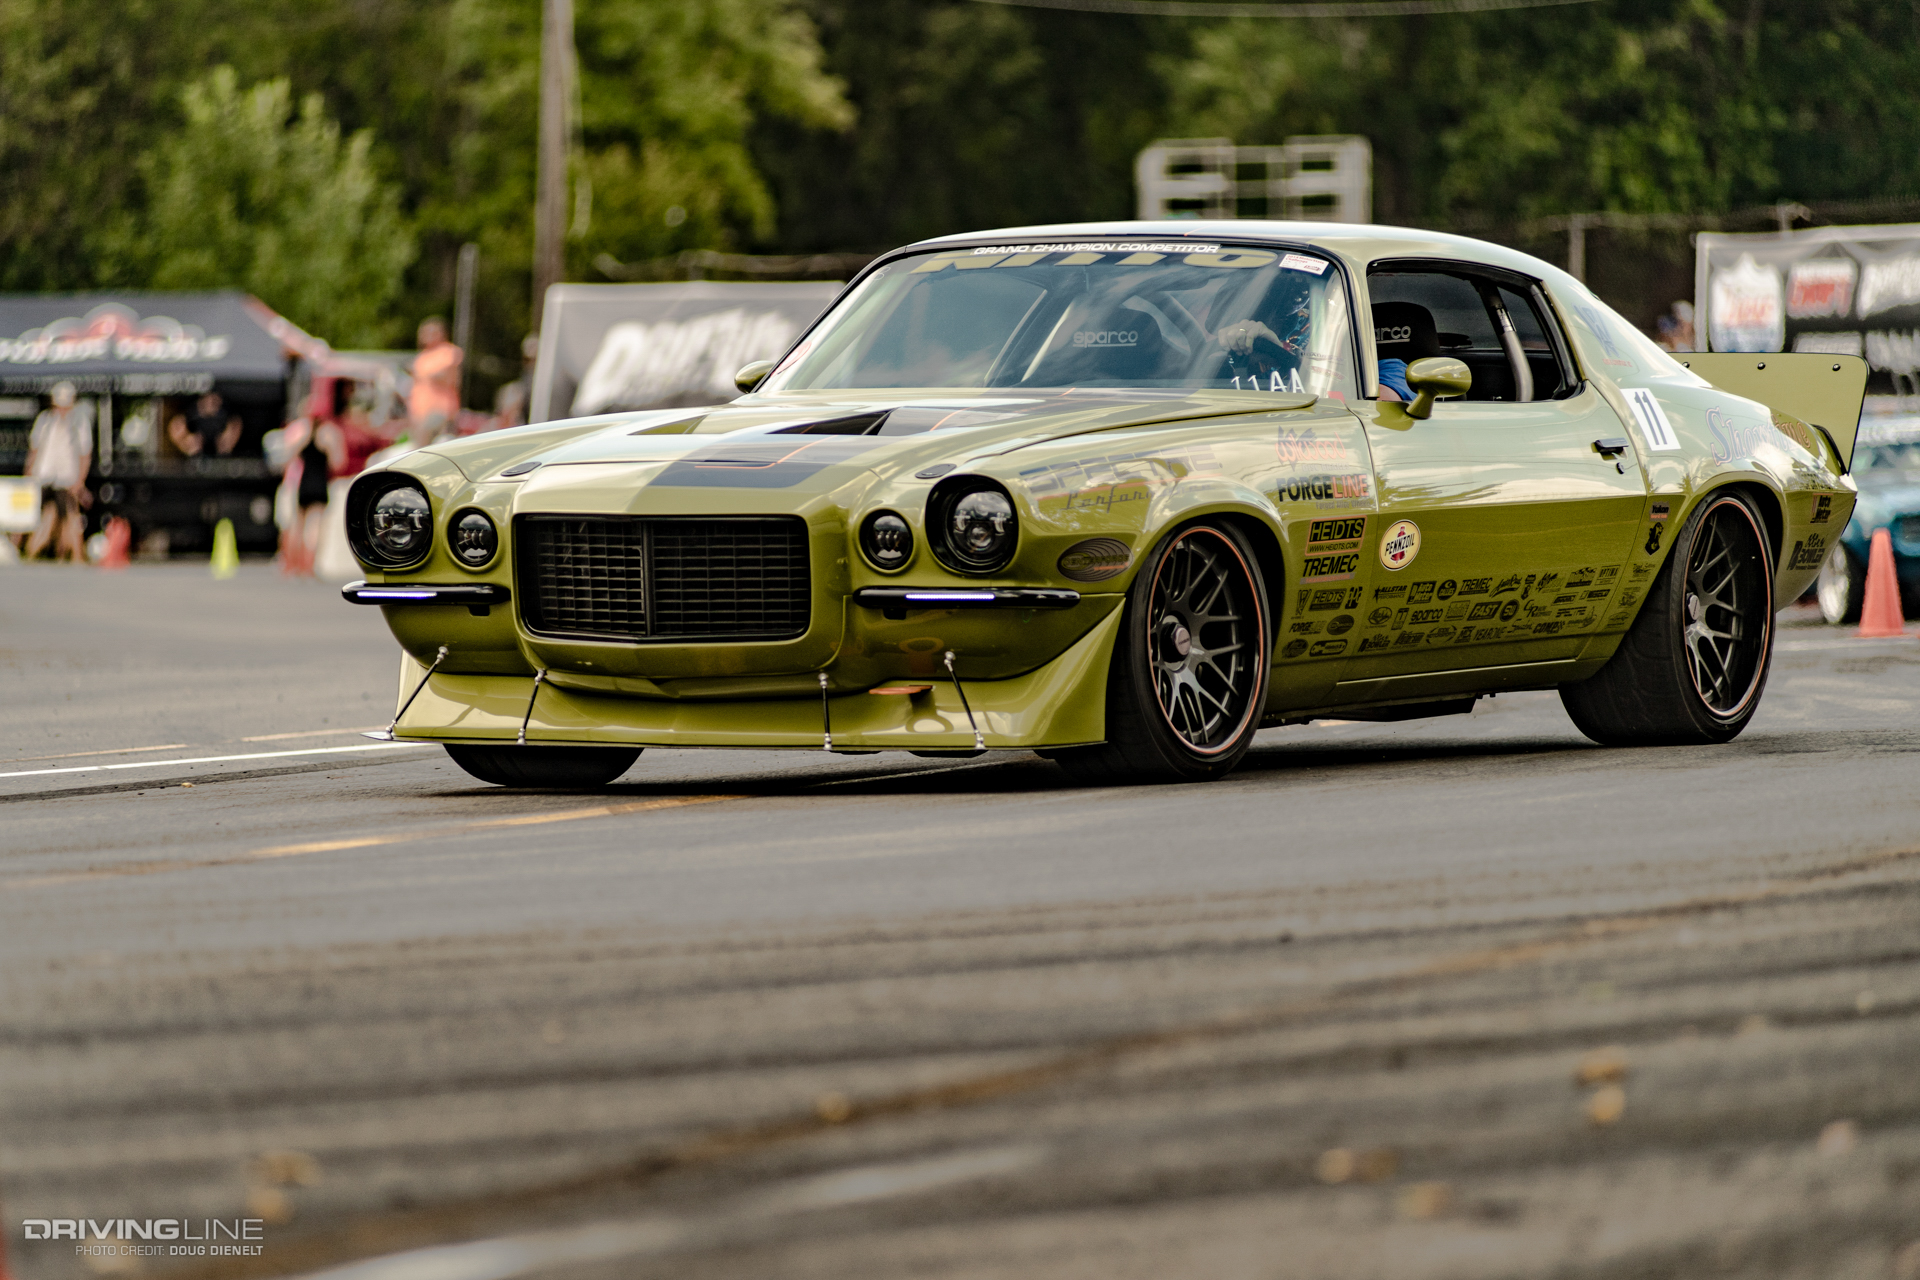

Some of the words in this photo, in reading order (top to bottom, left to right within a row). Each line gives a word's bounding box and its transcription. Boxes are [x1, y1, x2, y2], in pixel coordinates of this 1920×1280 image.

[973, 245, 1030, 255] GRAND
[1031, 243, 1113, 253] CHAMPION
[1115, 243, 1220, 254] COMPETITOR
[1073, 331, 1139, 348] sparco
[1634, 391, 1668, 446] 11
[1276, 473, 1370, 502] FORGELINE
[1310, 519, 1363, 541] HEIDTS
[1309, 542, 1359, 552] WWW.HEIDTS.COM
[1385, 533, 1415, 556] PENNZOIL
[1303, 554, 1359, 577] TREMEC
[1380, 585, 1408, 593] ALLSTAR
[1461, 577, 1493, 590] TREMEC
[1315, 591, 1344, 603] HEIDTS
[1411, 608, 1444, 625] sparco
[1473, 604, 1498, 617] FAST
